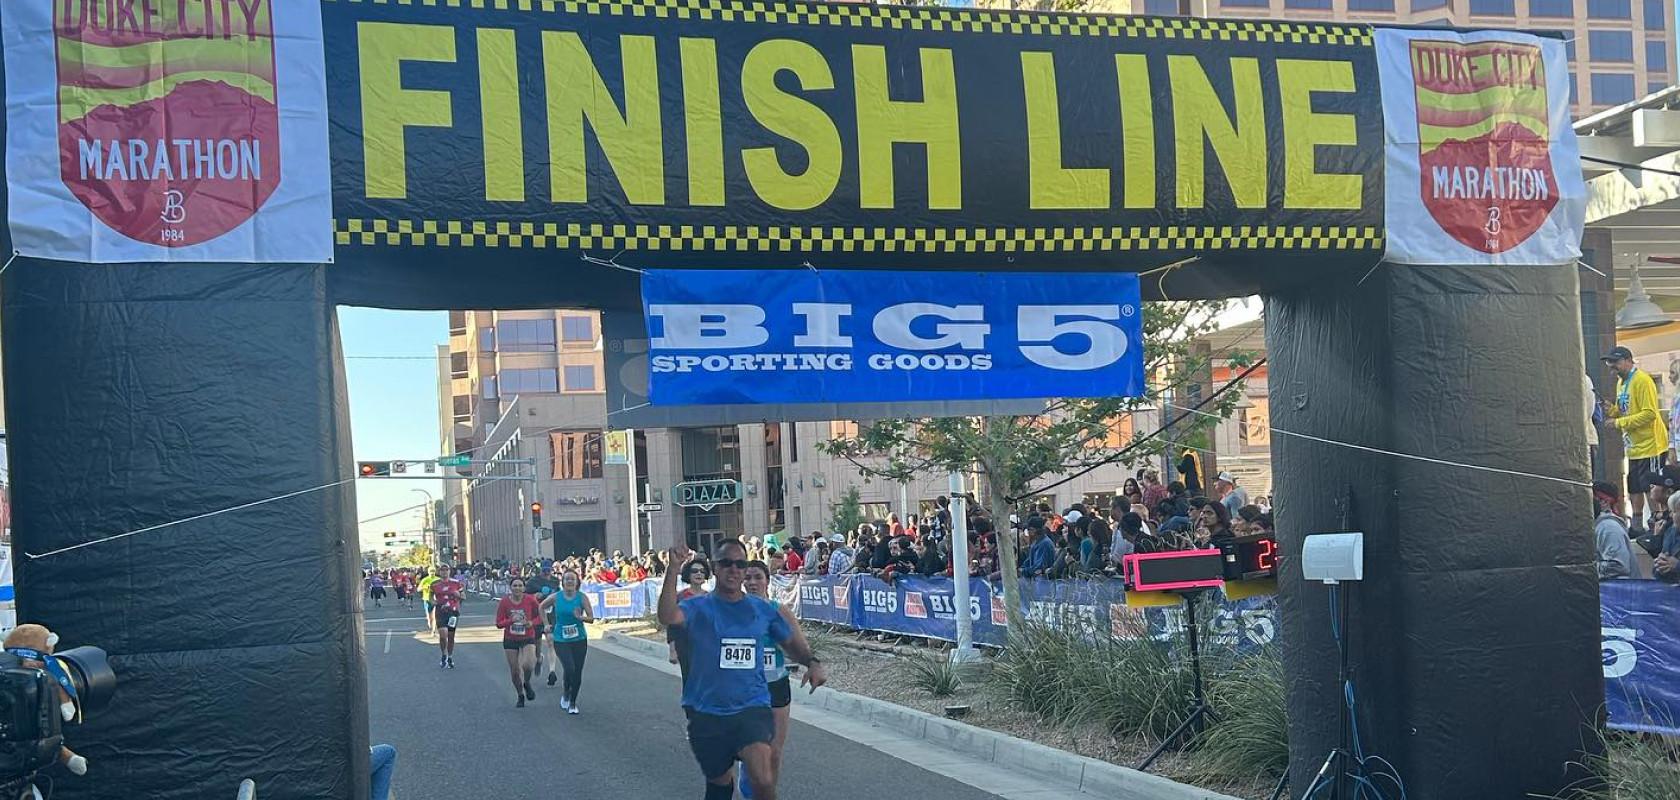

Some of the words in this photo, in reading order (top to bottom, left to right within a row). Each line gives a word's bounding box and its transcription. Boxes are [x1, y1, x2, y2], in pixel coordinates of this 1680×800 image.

[63, 0, 162, 37] DUKE
[177, 0, 261, 41] CITY
[1417, 47, 1485, 88] DUKE
[1492, 47, 1541, 90] CITY
[357, 21, 962, 211] FINISH
[1020, 51, 1363, 209] LINE
[79, 138, 262, 181] MARATHON
[1432, 165, 1550, 201] MARATHON
[161, 229, 184, 242] 1984
[650, 302, 992, 351] BIG
[651, 354, 853, 373] SPORTING
[869, 353, 993, 371] GOODS
[682, 485, 731, 502] PLAZA
[802, 586, 820, 599] BIG
[821, 587, 830, 605] 5
[863, 590, 886, 605] BIG
[887, 592, 898, 612] 5
[929, 595, 956, 612] BI
[725, 648, 752, 661] 8478
